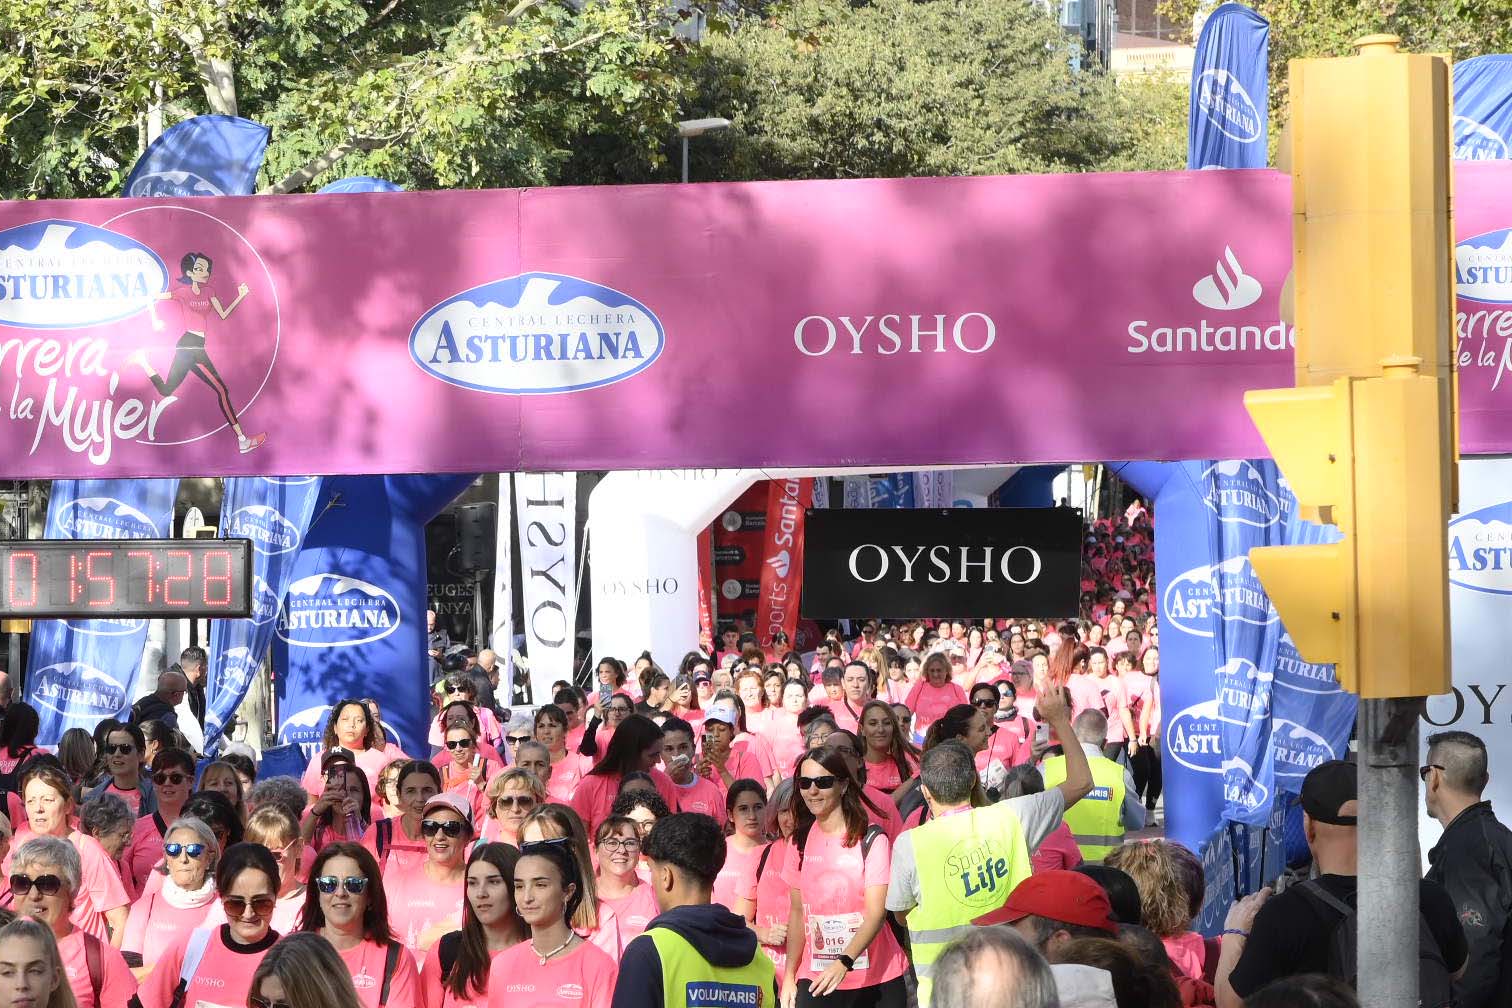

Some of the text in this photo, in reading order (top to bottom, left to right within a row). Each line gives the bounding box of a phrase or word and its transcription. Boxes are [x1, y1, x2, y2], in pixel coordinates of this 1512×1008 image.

[469, 313, 636, 328] CENTRAL LECHERA
[429, 319, 644, 364] ASTURIANA
[794, 312, 996, 357] OYSHO
[1127, 320, 1295, 353] Santand
[9, 380, 34, 419] la
[28, 371, 178, 466] Mujer
[848, 544, 1042, 585] OYSHO
[291, 598, 386, 608] CENTRAL LECHERA
[278, 605, 392, 632] ASTURIANA
[960, 857, 1009, 898] Life
[825, 936, 845, 946] 016
[194, 975, 225, 988] OYSHO
[506, 983, 536, 993] OYSHO
[688, 988, 757, 1004] VOLUNTARIS
